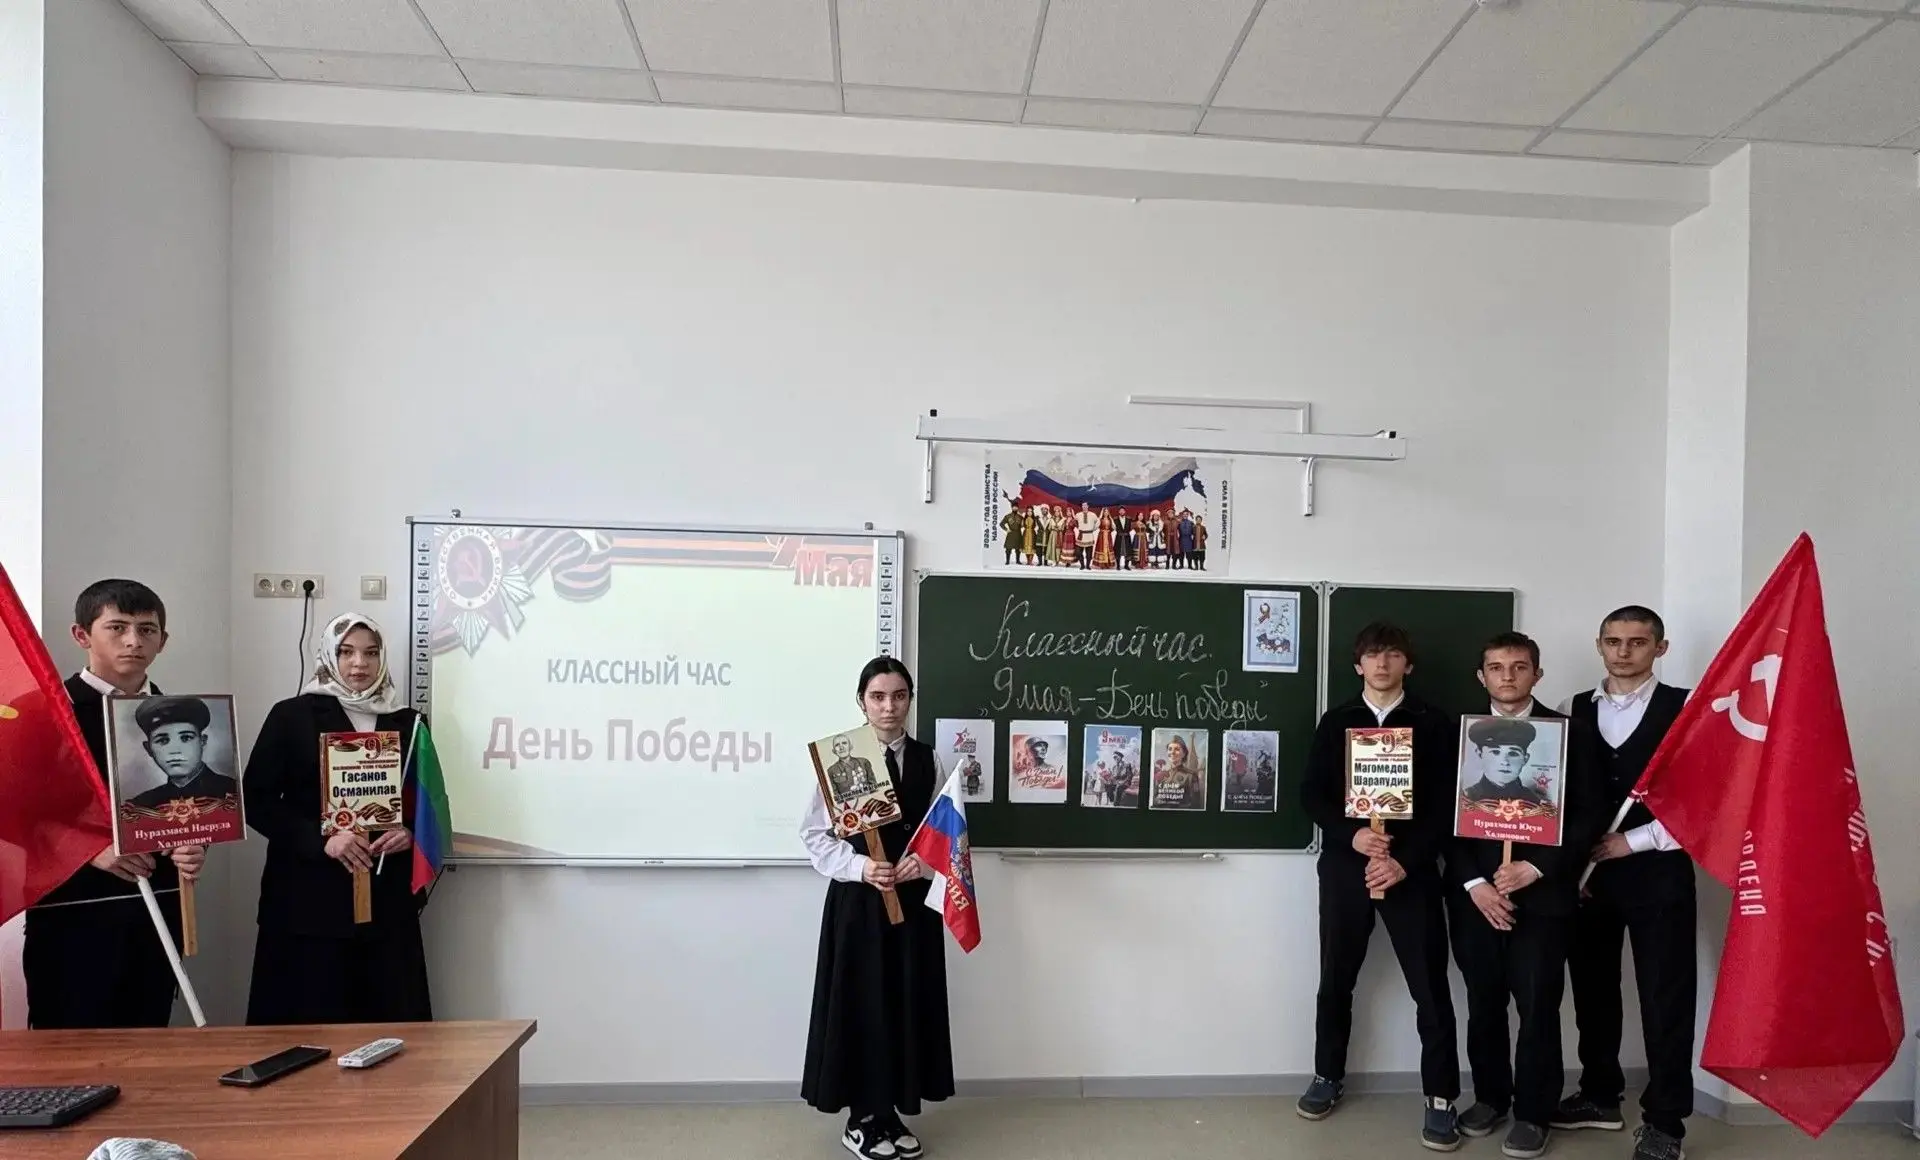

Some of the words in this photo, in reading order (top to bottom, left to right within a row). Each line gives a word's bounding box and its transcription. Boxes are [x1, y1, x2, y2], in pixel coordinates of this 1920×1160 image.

[792, 549, 873, 588] Мая
[546, 654, 680, 686] КЛАССНЫЙ
[686, 661, 732, 687] ЧАС
[482, 716, 594, 771] День
[606, 716, 773, 773] Победы
[1354, 762, 1409, 775] Магомедов
[341, 771, 388, 783] Гасанов
[1353, 775, 1410, 788] Шарапудин
[332, 784, 397, 798] Османилав
[157, 835, 213, 849] Халимович
